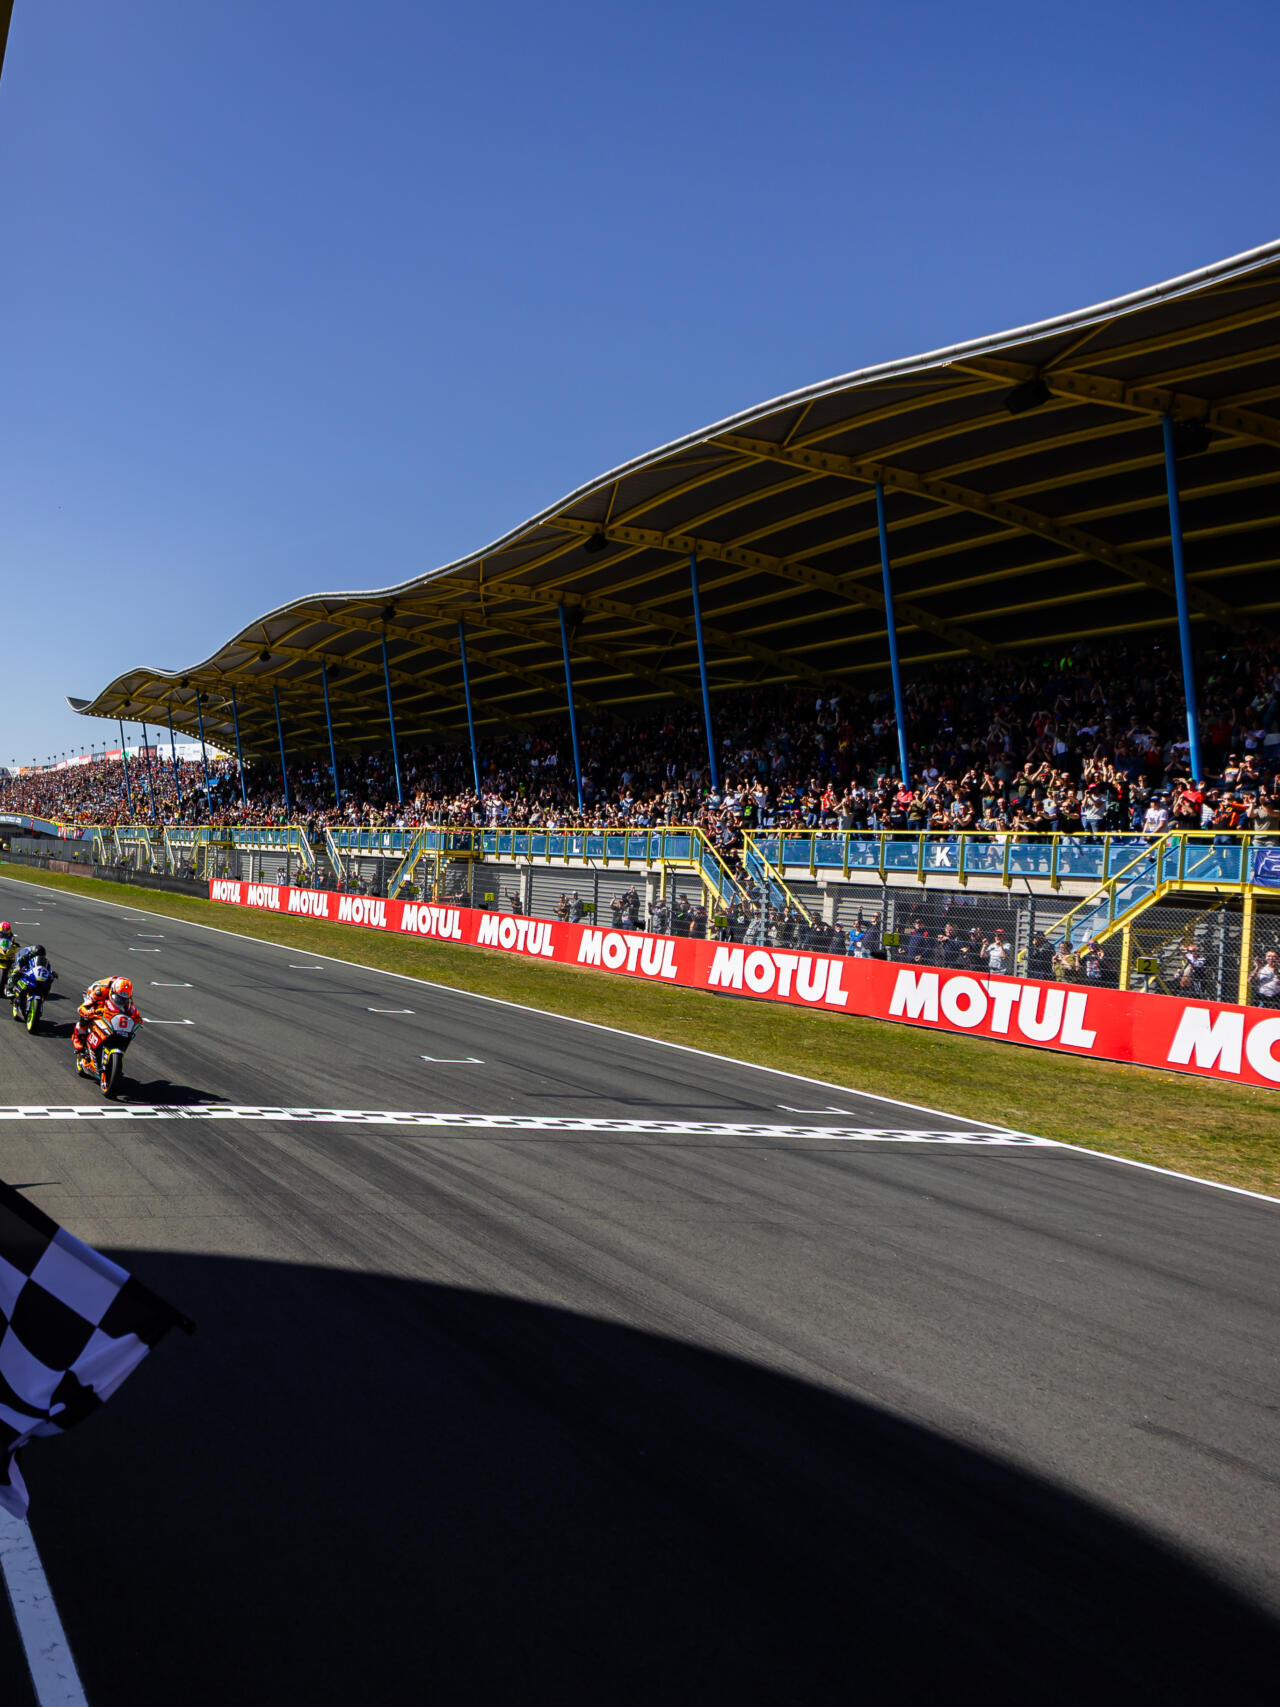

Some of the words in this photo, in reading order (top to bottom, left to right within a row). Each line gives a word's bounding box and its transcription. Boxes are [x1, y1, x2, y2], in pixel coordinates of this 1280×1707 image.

[572, 839, 580, 853] L
[935, 846, 951, 867] K
[212, 880, 241, 904] MOTUL
[247, 884, 281, 910] MOTUL
[288, 889, 329, 918] MOTUL
[338, 895, 387, 928] MOTUL
[400, 904, 463, 940] MOTUL
[477, 913, 555, 957] MOTUL
[577, 929, 678, 979] MOTUL
[1143, 960, 1152, 971] 2
[37, 968, 48, 978] 12
[707, 946, 849, 1006] MOTUL
[118, 1016, 128, 1029] 6
[888, 969, 1097, 1049] MOTUL
